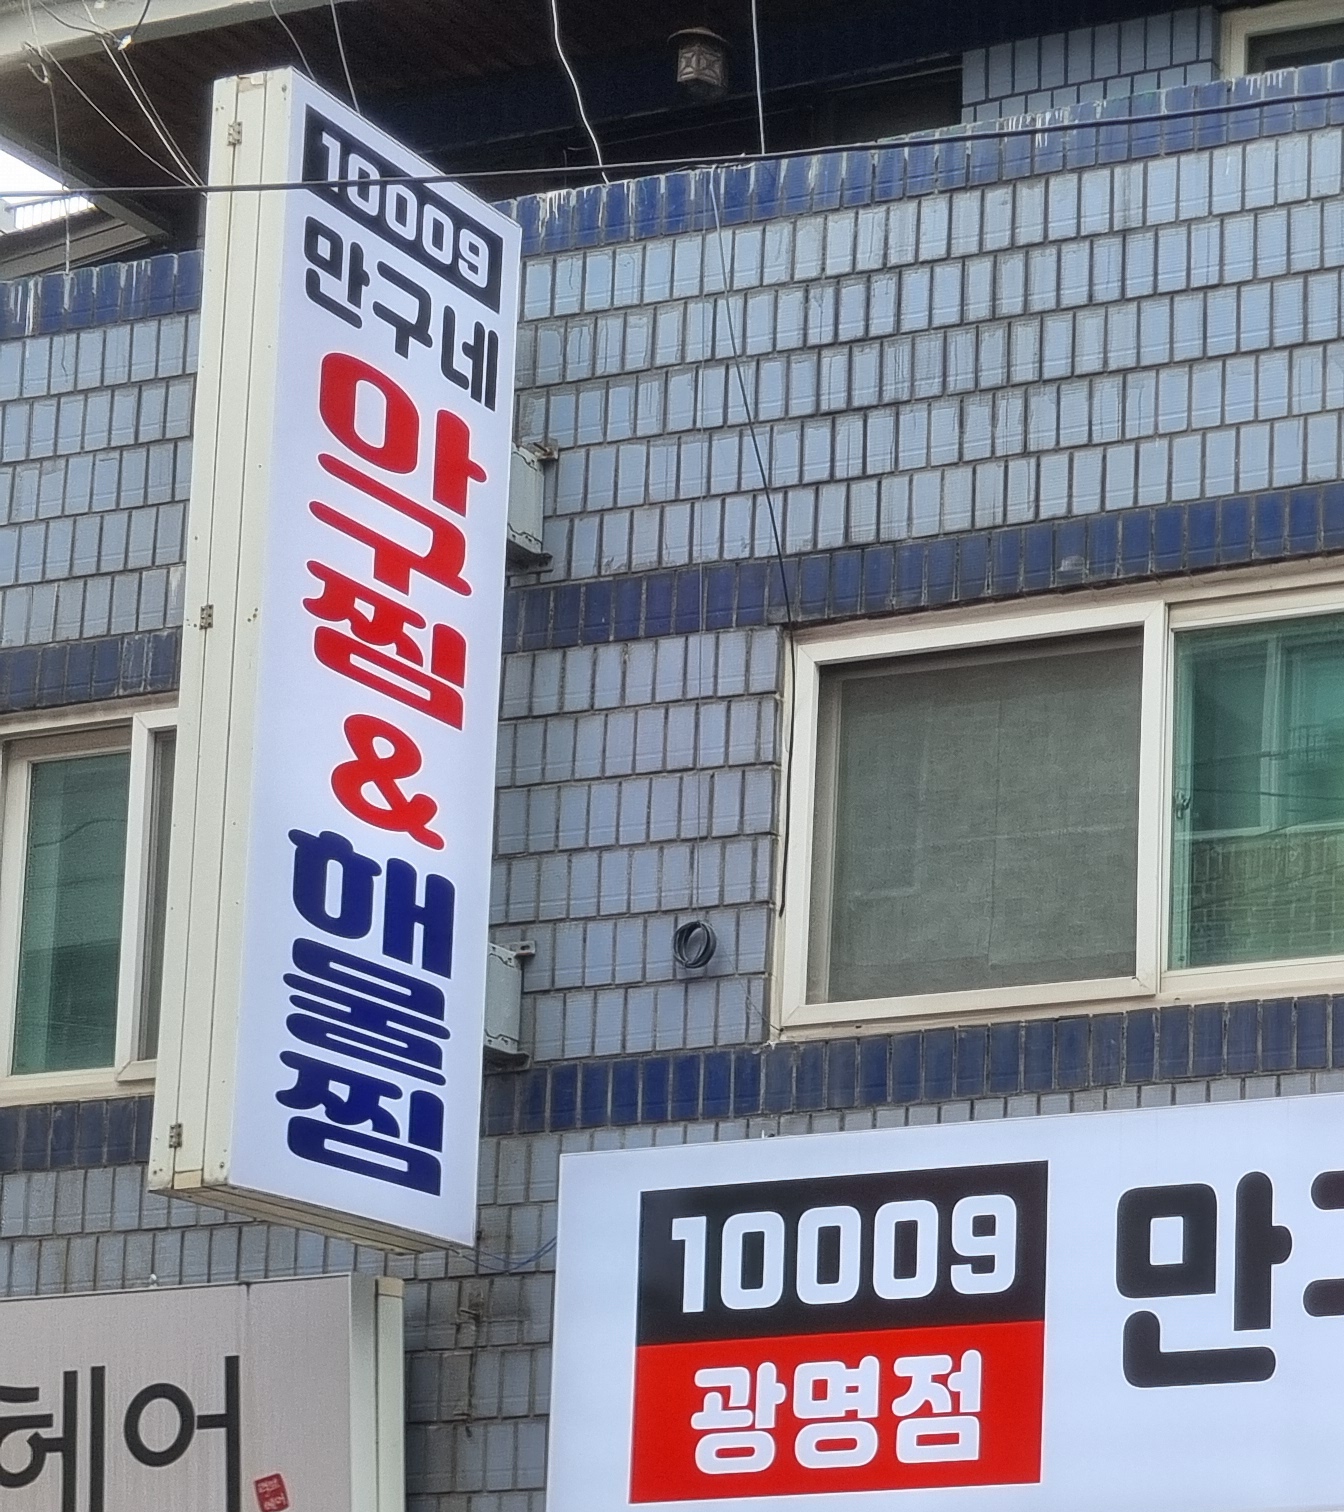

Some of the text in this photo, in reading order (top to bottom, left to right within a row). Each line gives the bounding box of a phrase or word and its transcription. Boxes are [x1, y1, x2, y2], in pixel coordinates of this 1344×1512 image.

[321, 133, 490, 289] 10009
[303, 215, 499, 411] 만구네
[671, 1194, 1017, 1314] 10009
[691, 1350, 982, 1475] 광명점
